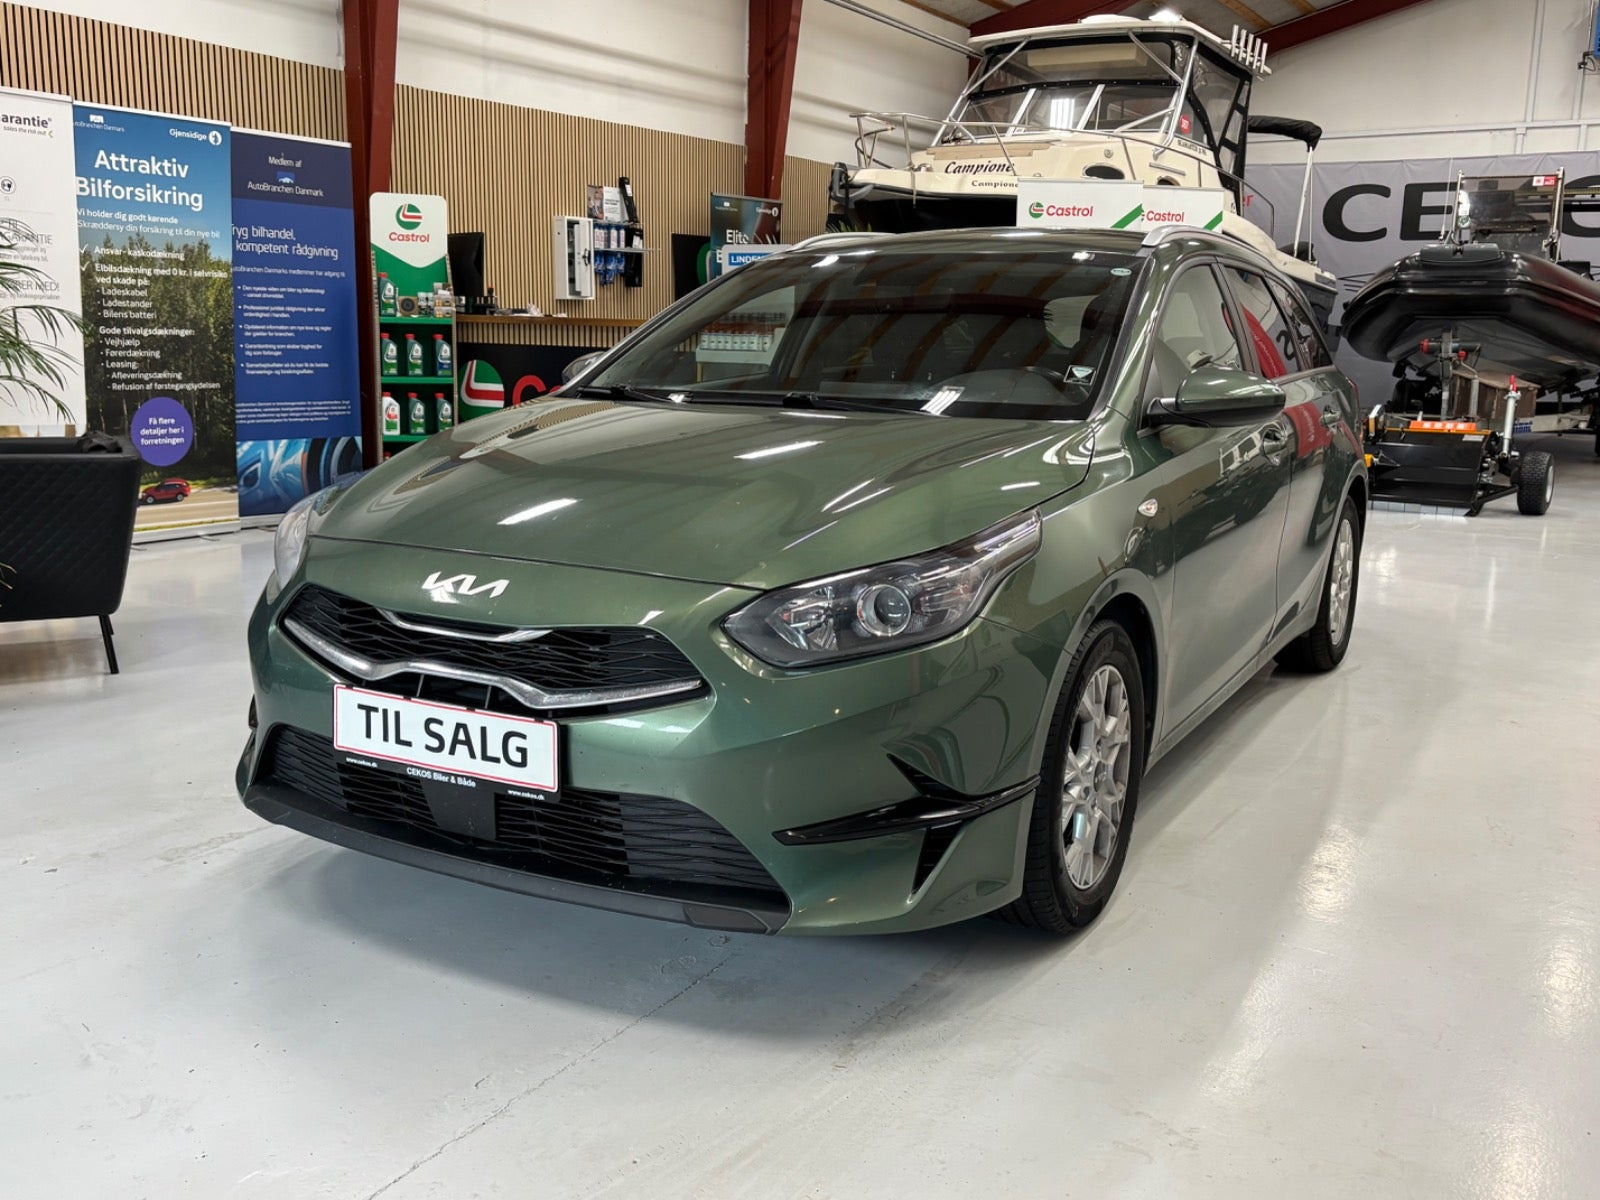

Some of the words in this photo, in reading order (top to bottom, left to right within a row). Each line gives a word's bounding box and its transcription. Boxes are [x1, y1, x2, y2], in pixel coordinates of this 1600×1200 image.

[0, 114, 48, 128] arantie
[169, 128, 207, 141] Gjensidige
[94, 149, 189, 178] Attraktiv
[76, 175, 203, 212] Bilforsikring
[247, 181, 294, 193] AutoBranchen
[295, 186, 324, 197] Danmark
[1046, 204, 1094, 217] Castrol
[1146, 210, 1185, 222] Castrol
[86, 209, 113, 219] holder
[114, 212, 127, 222] dig
[128, 215, 147, 225] godt
[78, 222, 124, 234] Skræddersy
[139, 226, 174, 237] forsikring
[251, 225, 296, 241] bilhandel,
[388, 231, 430, 243] Castrol
[235, 239, 290, 255] kompetent
[291, 243, 339, 261] rådgivning
[112, 278, 136, 286] skade
[102, 287, 148, 297] Ladeskabel
[103, 298, 152, 308] Ladestander
[103, 310, 128, 319] Bilens
[129, 310, 157, 319] batteri
[99, 326, 121, 335] Gode
[104, 338, 140, 347] Vejhjælp
[105, 349, 160, 359] Førerdækning
[149, 417, 158, 425] Få
[140, 428, 167, 436] detaljer
[140, 437, 184, 446] forretningen
[357, 703, 413, 748] TIL
[423, 716, 528, 768] SALG
[406, 766, 432, 780] CEKOS
[432, 772, 449, 783] Biler
[457, 776, 476, 788] Både
